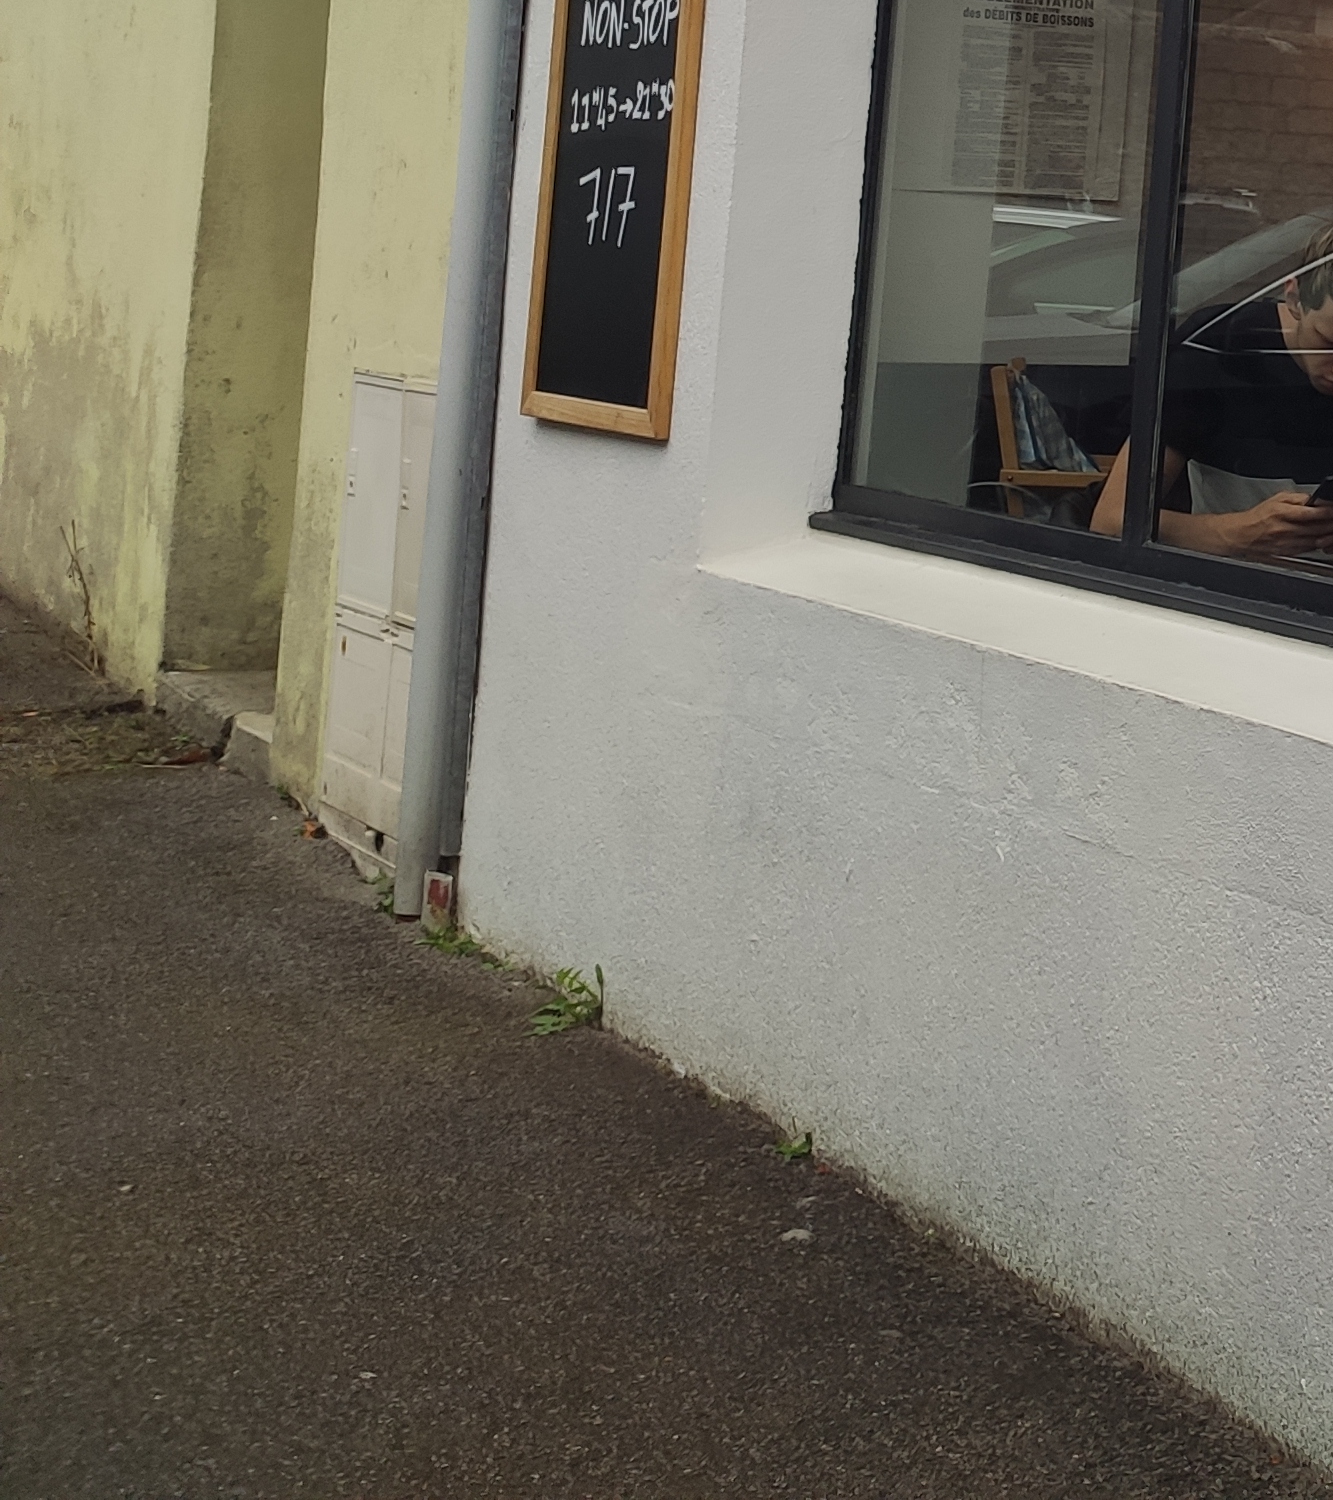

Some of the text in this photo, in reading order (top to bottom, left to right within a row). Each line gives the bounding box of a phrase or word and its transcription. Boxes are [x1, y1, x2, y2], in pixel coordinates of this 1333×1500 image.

[963, 7, 1094, 28] des DÉBITS DE BOISSONS
[579, 166, 636, 248] 7/7
